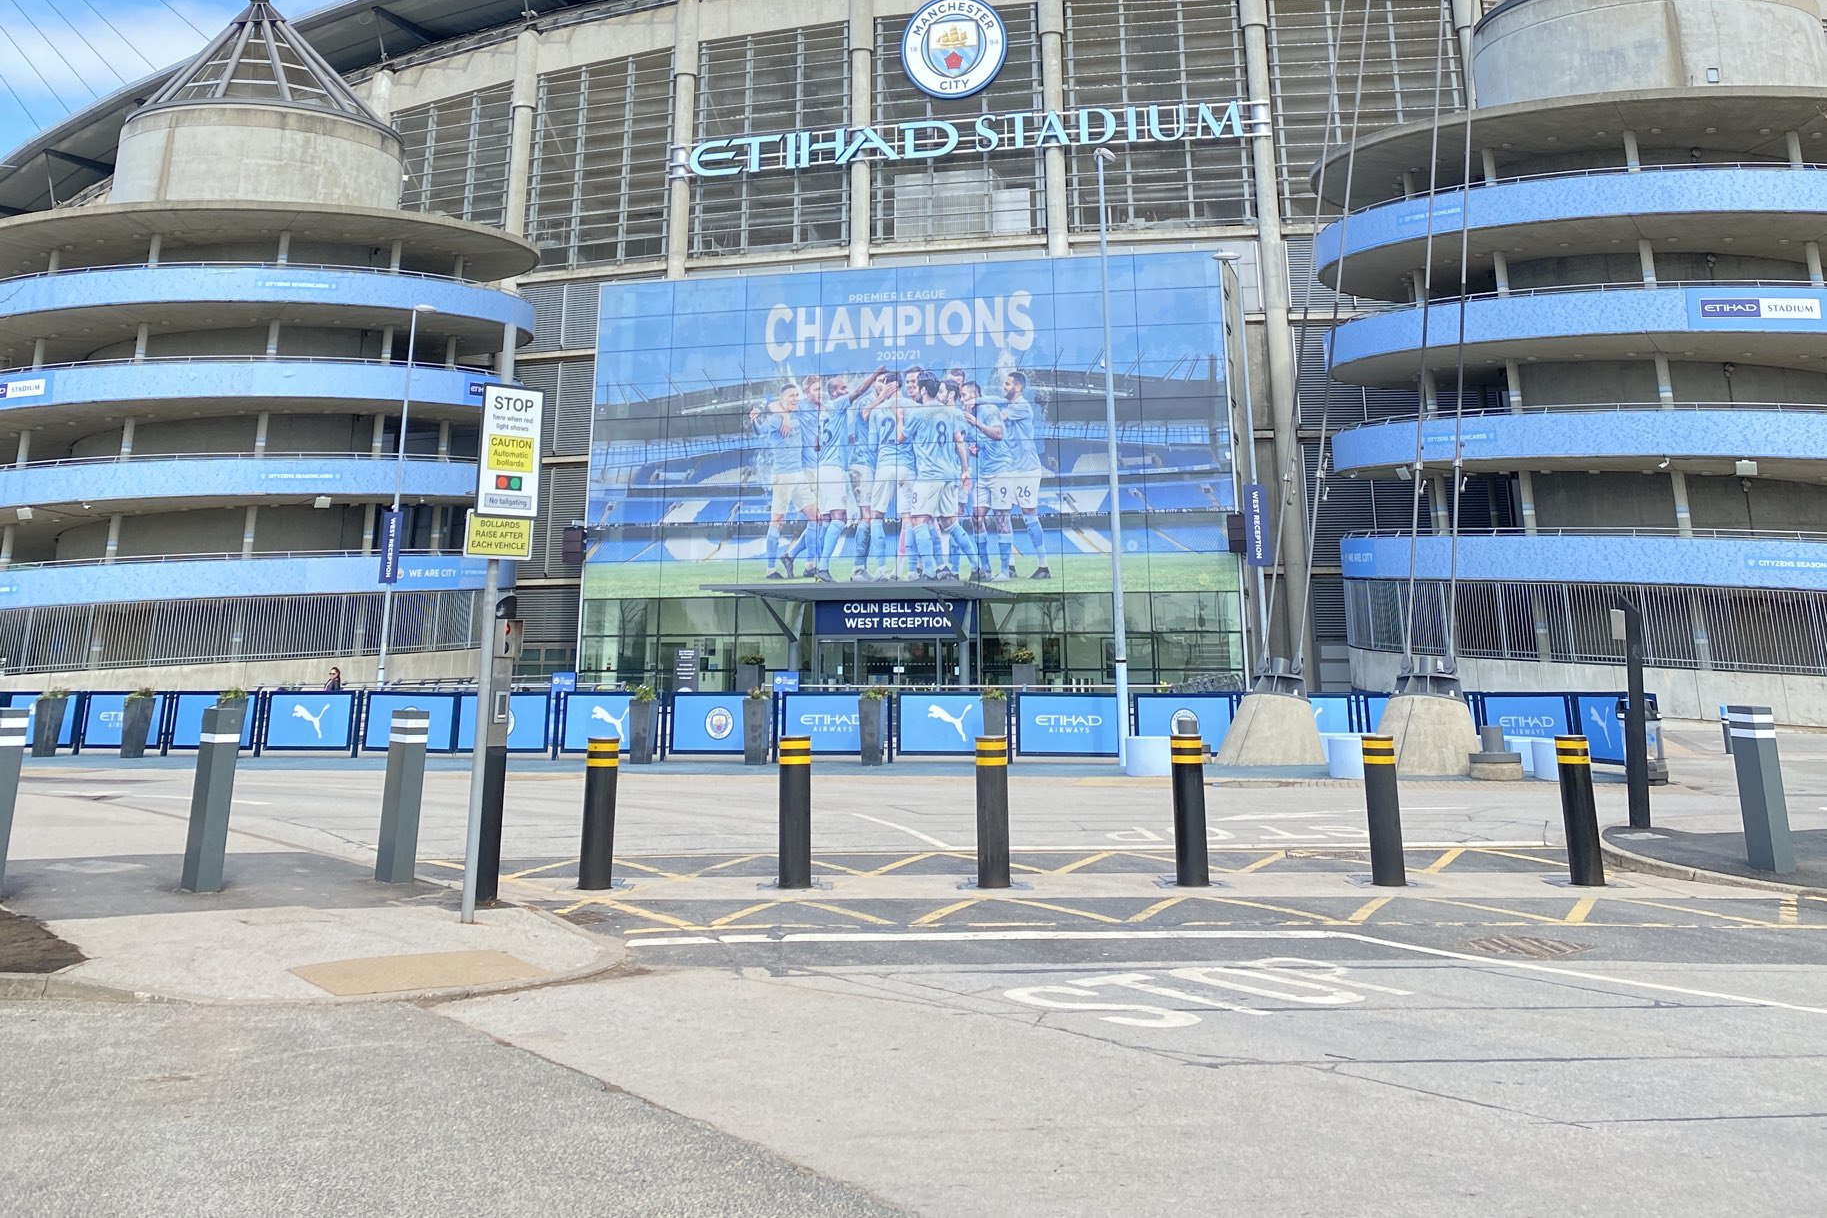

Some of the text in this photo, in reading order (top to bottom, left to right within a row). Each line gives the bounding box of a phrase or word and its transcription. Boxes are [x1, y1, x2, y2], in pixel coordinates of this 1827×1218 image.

[912, 1, 995, 36] MANCHESTER
[939, 79, 970, 91] CITY
[690, 99, 1246, 178] ETIHAD STADIUM
[848, 289, 946, 304] PREMIER LEAGUE
[1704, 303, 1814, 313] ETIHAD STADIUM
[765, 289, 1035, 362] CHAMPIONS
[876, 350, 921, 362] 2020/21
[11, 384, 41, 393] STADIUM
[493, 395, 534, 413] STOP
[492, 413, 534, 424] here when red
[496, 422, 529, 432] light shows
[936, 420, 947, 447] 8
[490, 437, 533, 450] CAUTION
[492, 449, 529, 460] Automatic
[496, 458, 525, 468] bollards
[999, 486, 1007, 499] 9
[1016, 485, 1031, 499] 26
[489, 497, 528, 508] No tailgating
[480, 520, 521, 529] BOLLARDS
[1251, 490, 1263, 560] WEST RECEPTION
[475, 530, 524, 539] RAISE AFTER
[385, 517, 397, 578] WEST RECEPTION
[471, 541, 526, 550] EACH VEHICLE
[1758, 559, 1795, 567] CITYZENS
[409, 570, 421, 578] WE
[424, 569, 439, 578] ARE
[440, 569, 457, 578] CITY
[843, 603, 879, 614] COLIN
[882, 602, 912, 613] BELL
[845, 616, 952, 629] WEST RECEPTION
[99, 711, 124, 722] ETI
[800, 714, 860, 725] ETIHAD
[1035, 714, 1103, 726] ETIHAD
[1498, 715, 1555, 728] ETIHAD
[1003, 956, 1415, 1029] STOP
